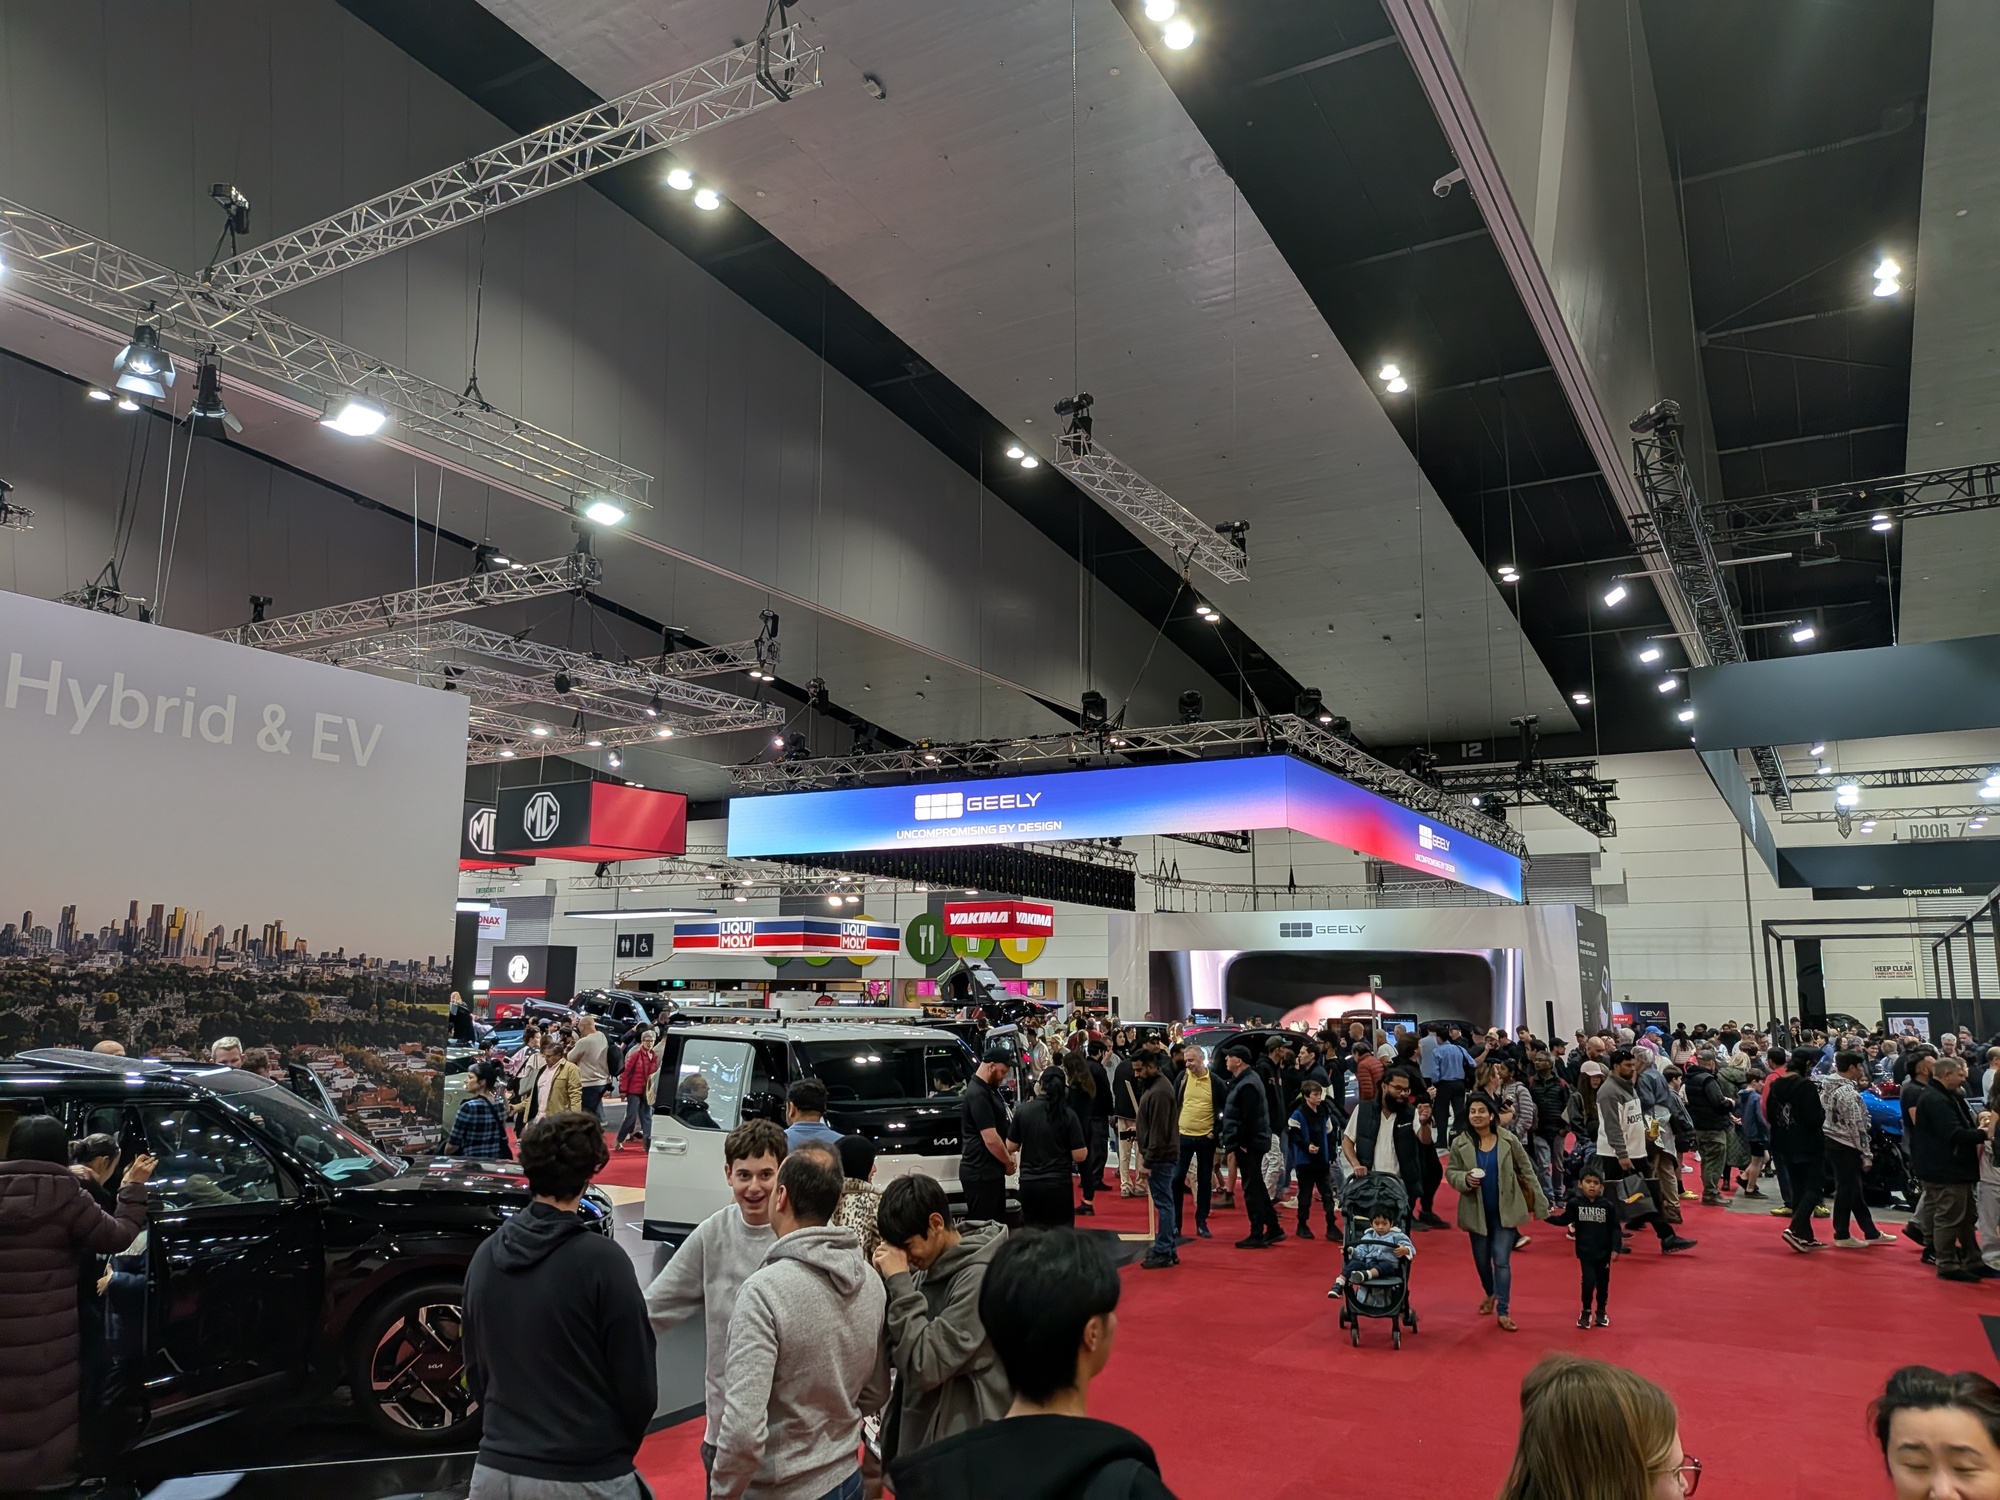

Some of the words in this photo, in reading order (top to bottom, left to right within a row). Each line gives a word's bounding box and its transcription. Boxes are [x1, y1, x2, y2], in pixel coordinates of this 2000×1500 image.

[4, 652, 238, 745] Hybrid
[256, 703, 293, 755] &
[311, 711, 384, 767] EV
[1461, 742, 1483, 758] 12
[966, 791, 1042, 812] GEELY
[525, 795, 558, 839] MG
[896, 824, 997, 840] UNCOMPROMISING
[999, 823, 1016, 834] BY
[1018, 820, 1063, 832] DESIGN
[1909, 823, 1950, 839] DOOR
[1956, 822, 1966, 838] 7
[1432, 834, 1451, 852] GEELY
[1902, 888, 1922, 896] Open
[1924, 888, 1941, 896] your
[1942, 886, 1964, 894] mind.
[950, 911, 1009, 925] YAKIMA
[1016, 912, 1052, 926] YAKIMA
[722, 922, 752, 934] LIQUI
[842, 924, 866, 936] LIQUI
[1316, 924, 1366, 934] GEELY
[721, 935, 752, 948] MOLY
[842, 936, 866, 950] MOLY
[933, 1137, 958, 1146] KIA
[1578, 1206, 1606, 1216] KINGS
